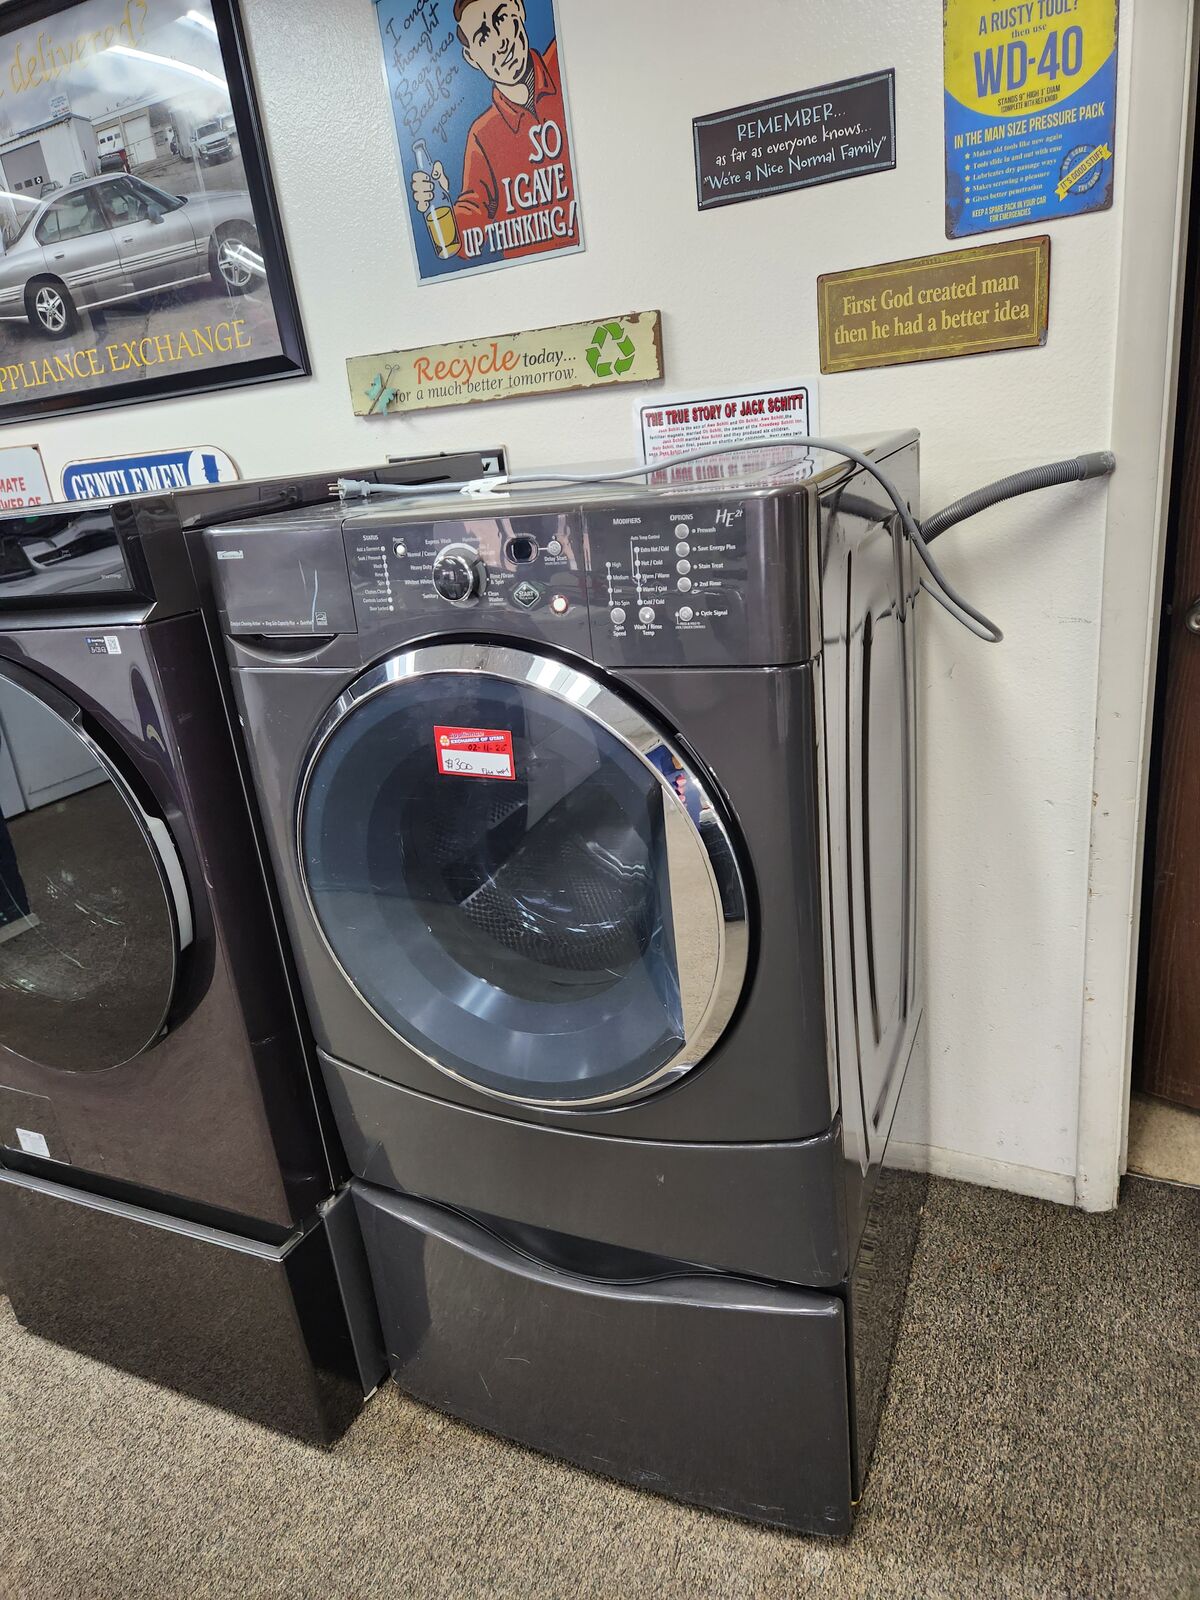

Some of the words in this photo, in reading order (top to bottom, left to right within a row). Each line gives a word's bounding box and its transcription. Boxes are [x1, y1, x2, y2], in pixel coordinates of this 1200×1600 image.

[386, 17, 401, 48] I
[404, 0, 431, 30] onc
[393, 3, 439, 75] thought
[978, 15, 988, 36] A
[991, 2, 1034, 33] RUSTY
[1011, 28, 1030, 40] then
[1033, 23, 1047, 34] use
[9, 0, 148, 94] delivered?
[973, 25, 1083, 98] WD-40
[396, 66, 431, 108] Beer
[431, 31, 454, 63] was
[404, 79, 439, 137] Bad
[436, 65, 458, 100] for
[528, 119, 563, 163] SO
[954, 134, 963, 149] IN
[966, 131, 983, 147] THE
[984, 125, 1005, 142] MAN
[1007, 120, 1027, 136] SIZE
[1029, 109, 1076, 133] PRESSURE
[1079, 101, 1105, 122] PACK
[715, 153, 726, 168] as
[730, 147, 748, 163] far
[751, 149, 763, 163] as
[767, 133, 818, 155] everyone
[745, 171, 752, 182] a
[755, 163, 785, 183] Nice
[788, 146, 835, 175] Normal
[973, 149, 992, 159] Makes
[993, 146, 1003, 155] old
[1071, 163, 1087, 180] GOOD
[1086, 148, 1104, 166] STUFF
[501, 177, 516, 214] I
[514, 163, 569, 210] GAVE
[462, 227, 485, 258] UP
[484, 200, 577, 253] THINKING!
[843, 294, 878, 317] First
[881, 285, 914, 310] God
[917, 275, 977, 306] created
[981, 275, 1020, 295] man
[834, 325, 868, 345] then
[872, 320, 890, 340] he
[894, 313, 924, 337] had
[928, 317, 937, 332] a
[941, 309, 990, 330] better
[994, 300, 1030, 322] idea
[107, 319, 253, 371] EXCHANGE
[413, 343, 521, 385] Recycle
[416, 393, 424, 401] a
[428, 380, 462, 399] much
[467, 376, 503, 395] better
[509, 368, 577, 389] tomorrow.
[645, 410, 664, 428] THE
[666, 407, 690, 425] TRUE
[692, 403, 721, 423] STORY
[725, 401, 737, 418] OF
[740, 397, 765, 417] JACK
[767, 394, 804, 413] SCHITT
[72, 463, 187, 501] GENTLEMEN
[613, 517, 642, 526] MODIFIERS
[669, 513, 694, 522] OPTIONS
[710, 544, 725, 552] Energy
[700, 609, 713, 617] Cycle
[713, 609, 728, 617] Signal
